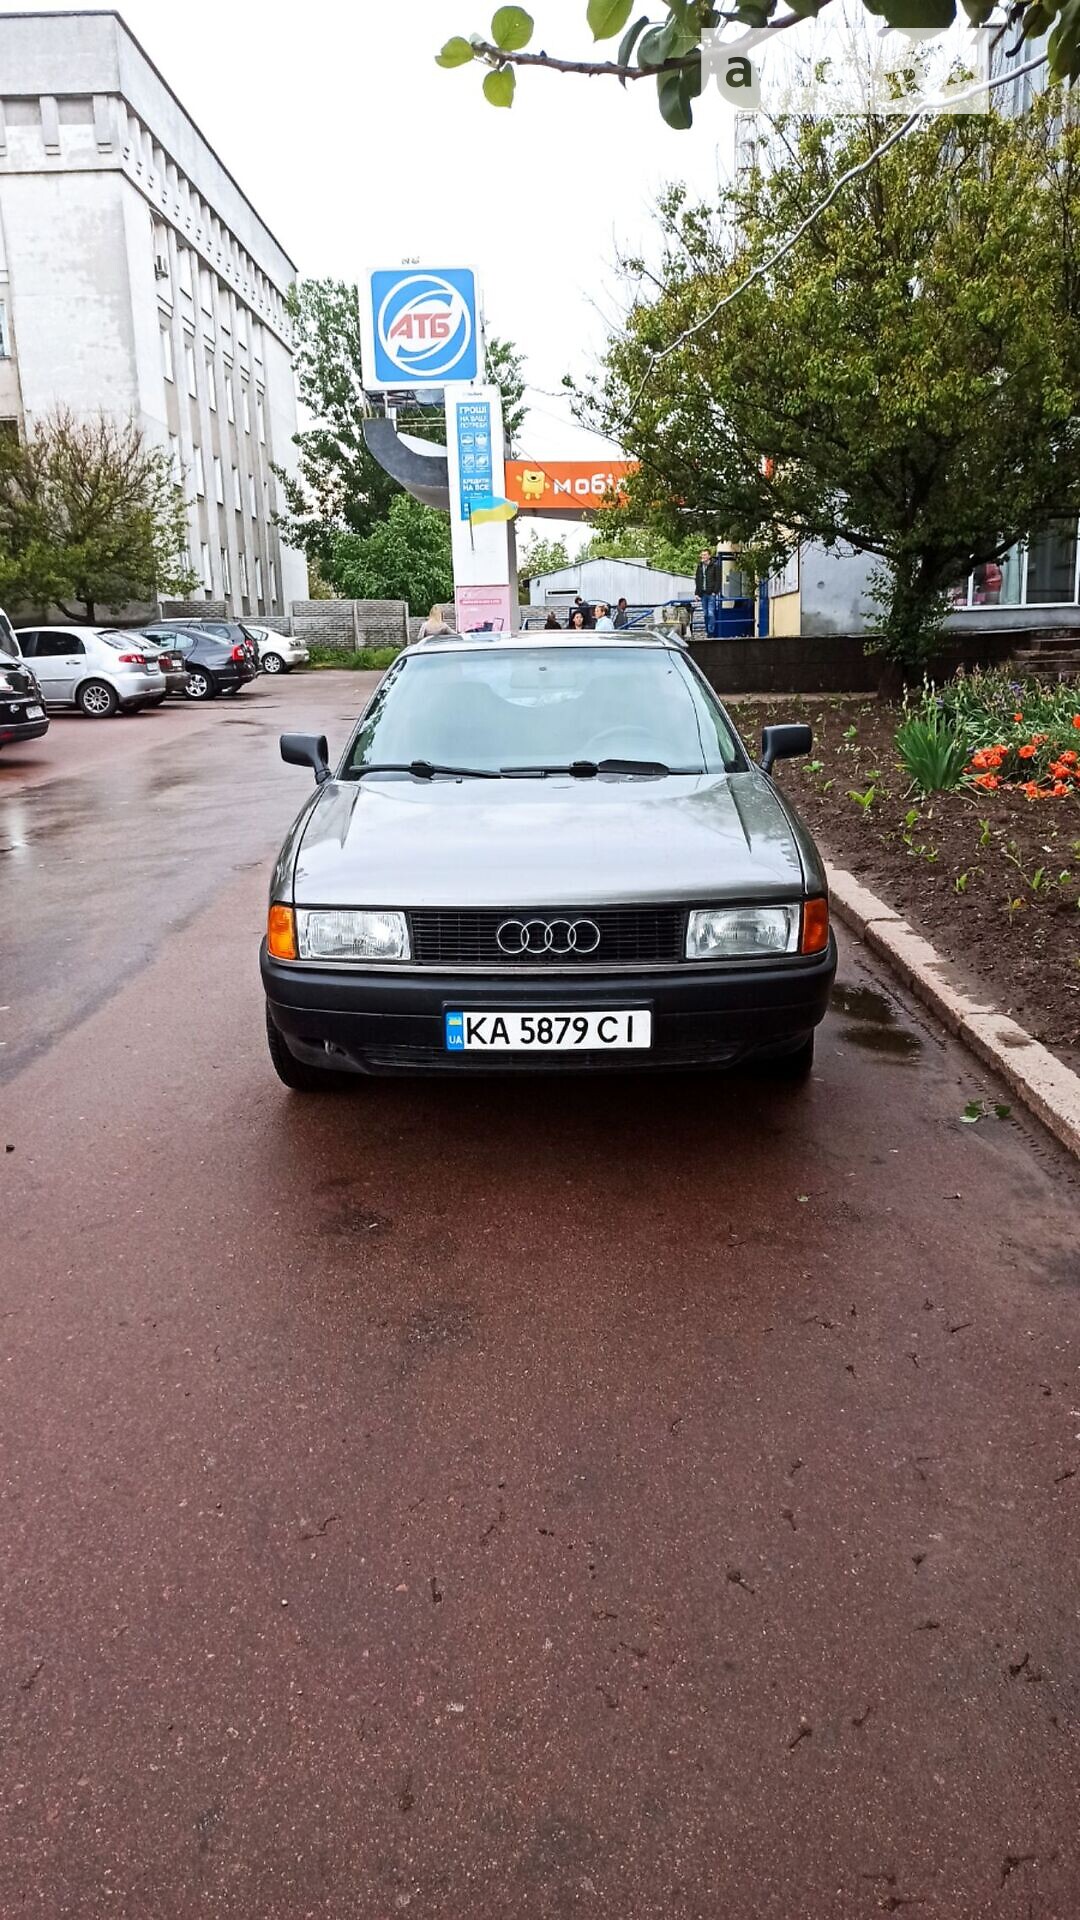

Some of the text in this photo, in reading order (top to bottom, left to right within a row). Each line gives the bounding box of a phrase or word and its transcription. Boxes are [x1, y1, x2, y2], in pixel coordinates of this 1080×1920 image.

[390, 312, 452, 339] АТБ
[459, 405, 487, 414] ГРОШІ
[449, 1015, 633, 1044] UA KA 5879 CI
